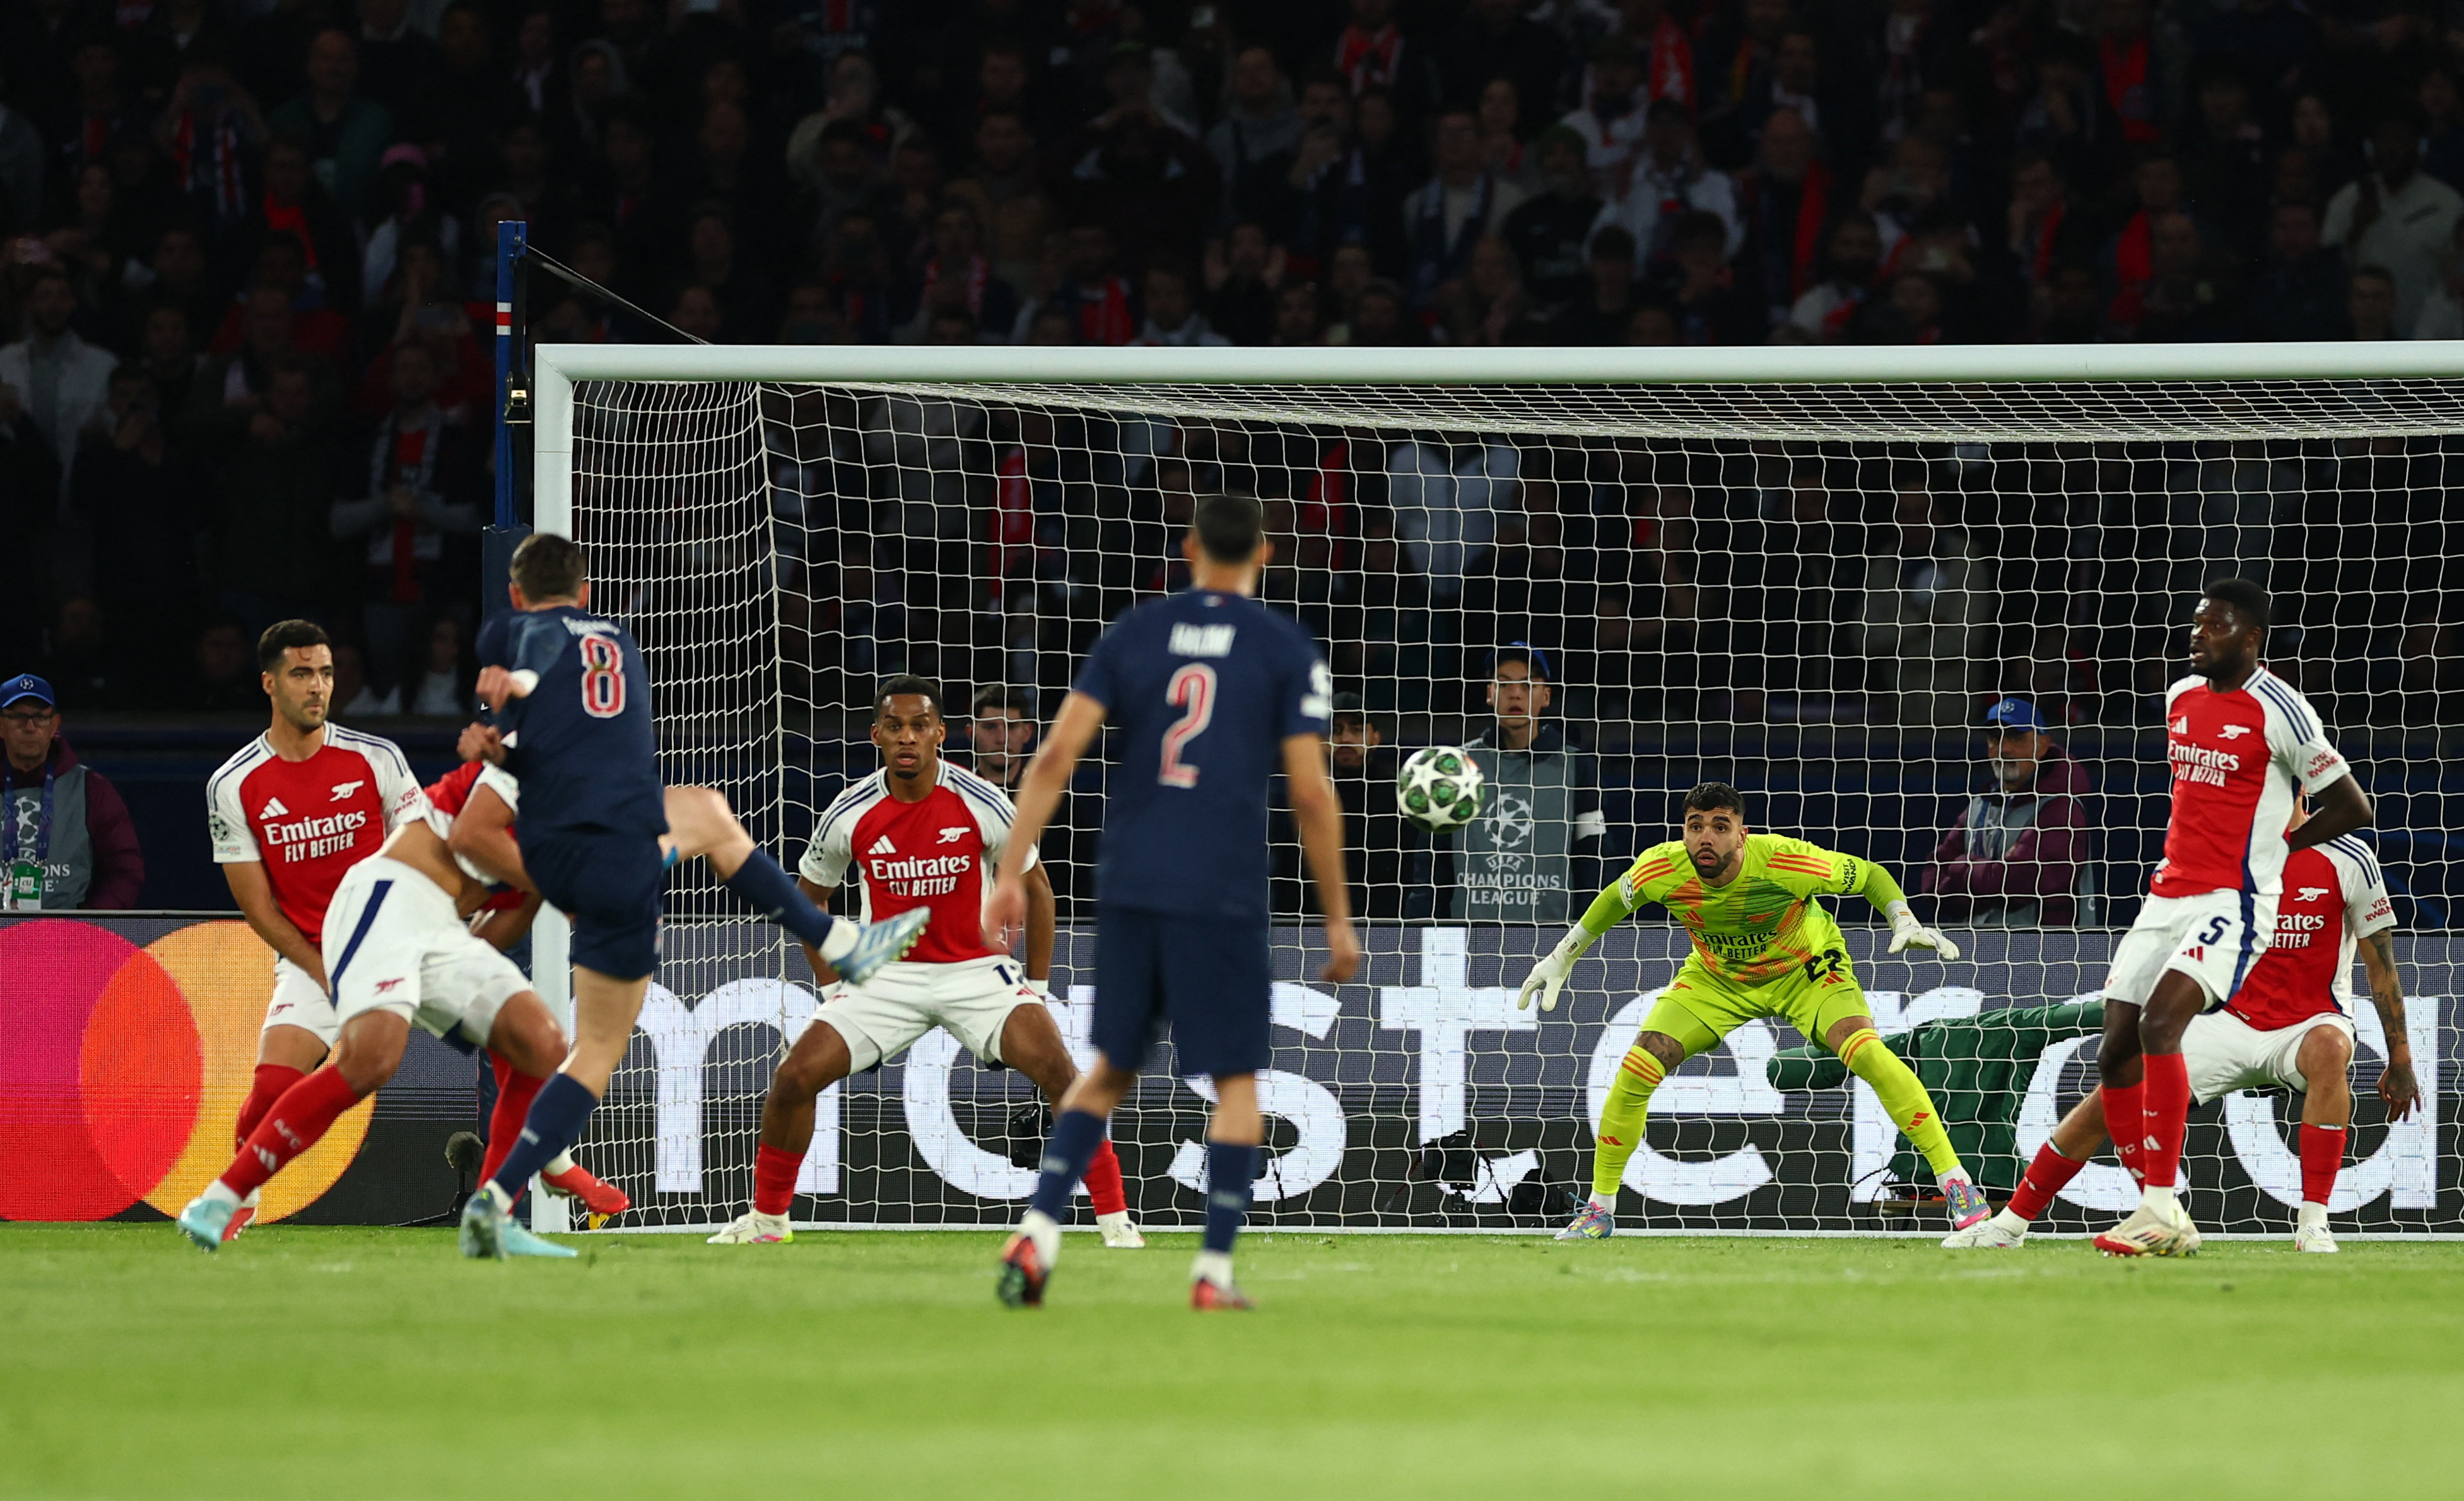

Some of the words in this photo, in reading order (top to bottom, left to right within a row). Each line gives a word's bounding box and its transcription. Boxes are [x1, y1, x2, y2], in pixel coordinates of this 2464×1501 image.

[579, 633, 626, 719] 8
[1158, 662, 1217, 789] 2
[2168, 739, 2240, 771] Emirates
[264, 810, 367, 845] Emirates
[285, 842, 305, 863] FLY
[310, 831, 355, 858] BETTER
[870, 855, 971, 880] Emirates
[1841, 863, 1850, 885] VISIT
[889, 881, 908, 896] FLY
[912, 876, 957, 897] BETTER
[1457, 872, 1561, 888] CHAMPIONS
[1470, 890, 1540, 905] LEAGUE
[2371, 897, 2387, 909] VIS
[2277, 913, 2325, 930] rates
[2365, 906, 2393, 922] RWAN
[2198, 916, 2231, 945] 5
[1707, 943, 1723, 955] FLY
[1727, 944, 1767, 959] BETTER
[1805, 949, 1846, 983] 22
